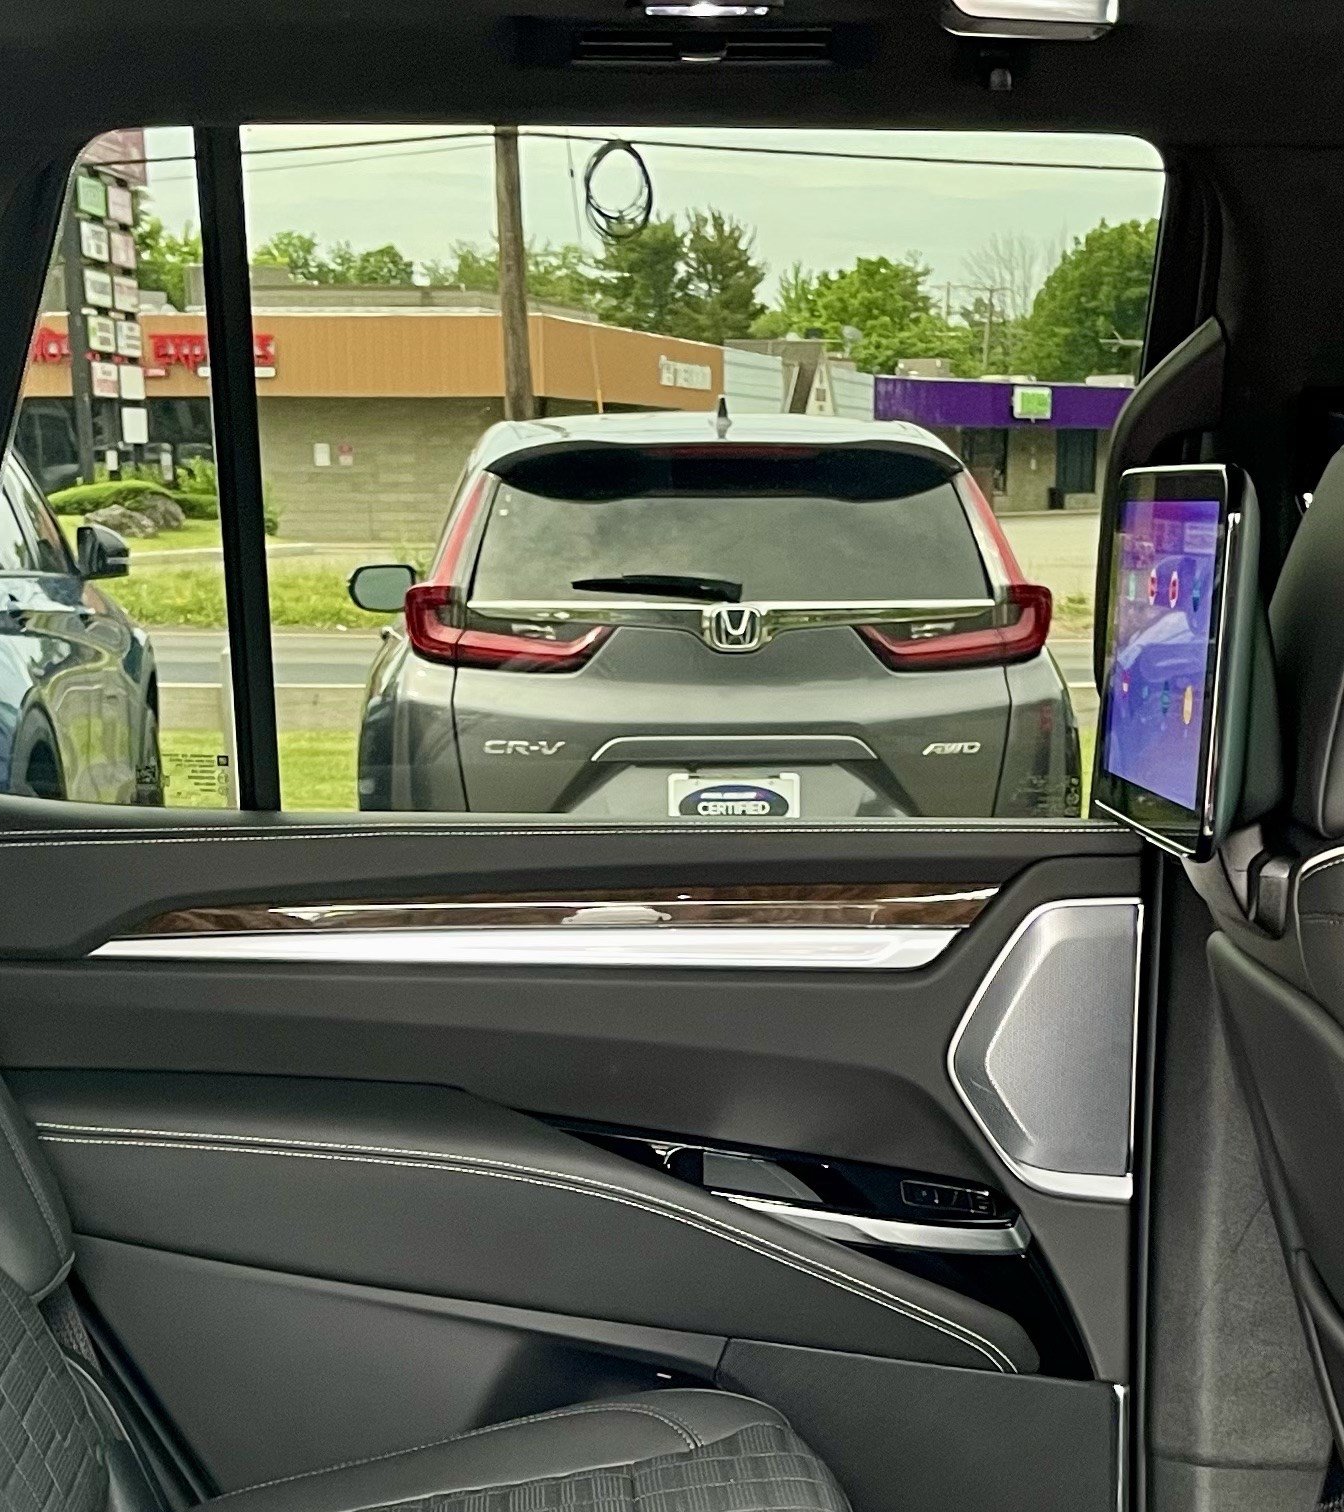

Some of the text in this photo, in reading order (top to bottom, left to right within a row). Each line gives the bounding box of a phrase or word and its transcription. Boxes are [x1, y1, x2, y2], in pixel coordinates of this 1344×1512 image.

[483, 740, 566, 755] CR-V
[922, 741, 981, 755] AWD
[697, 801, 771, 816] CERTIFIED
